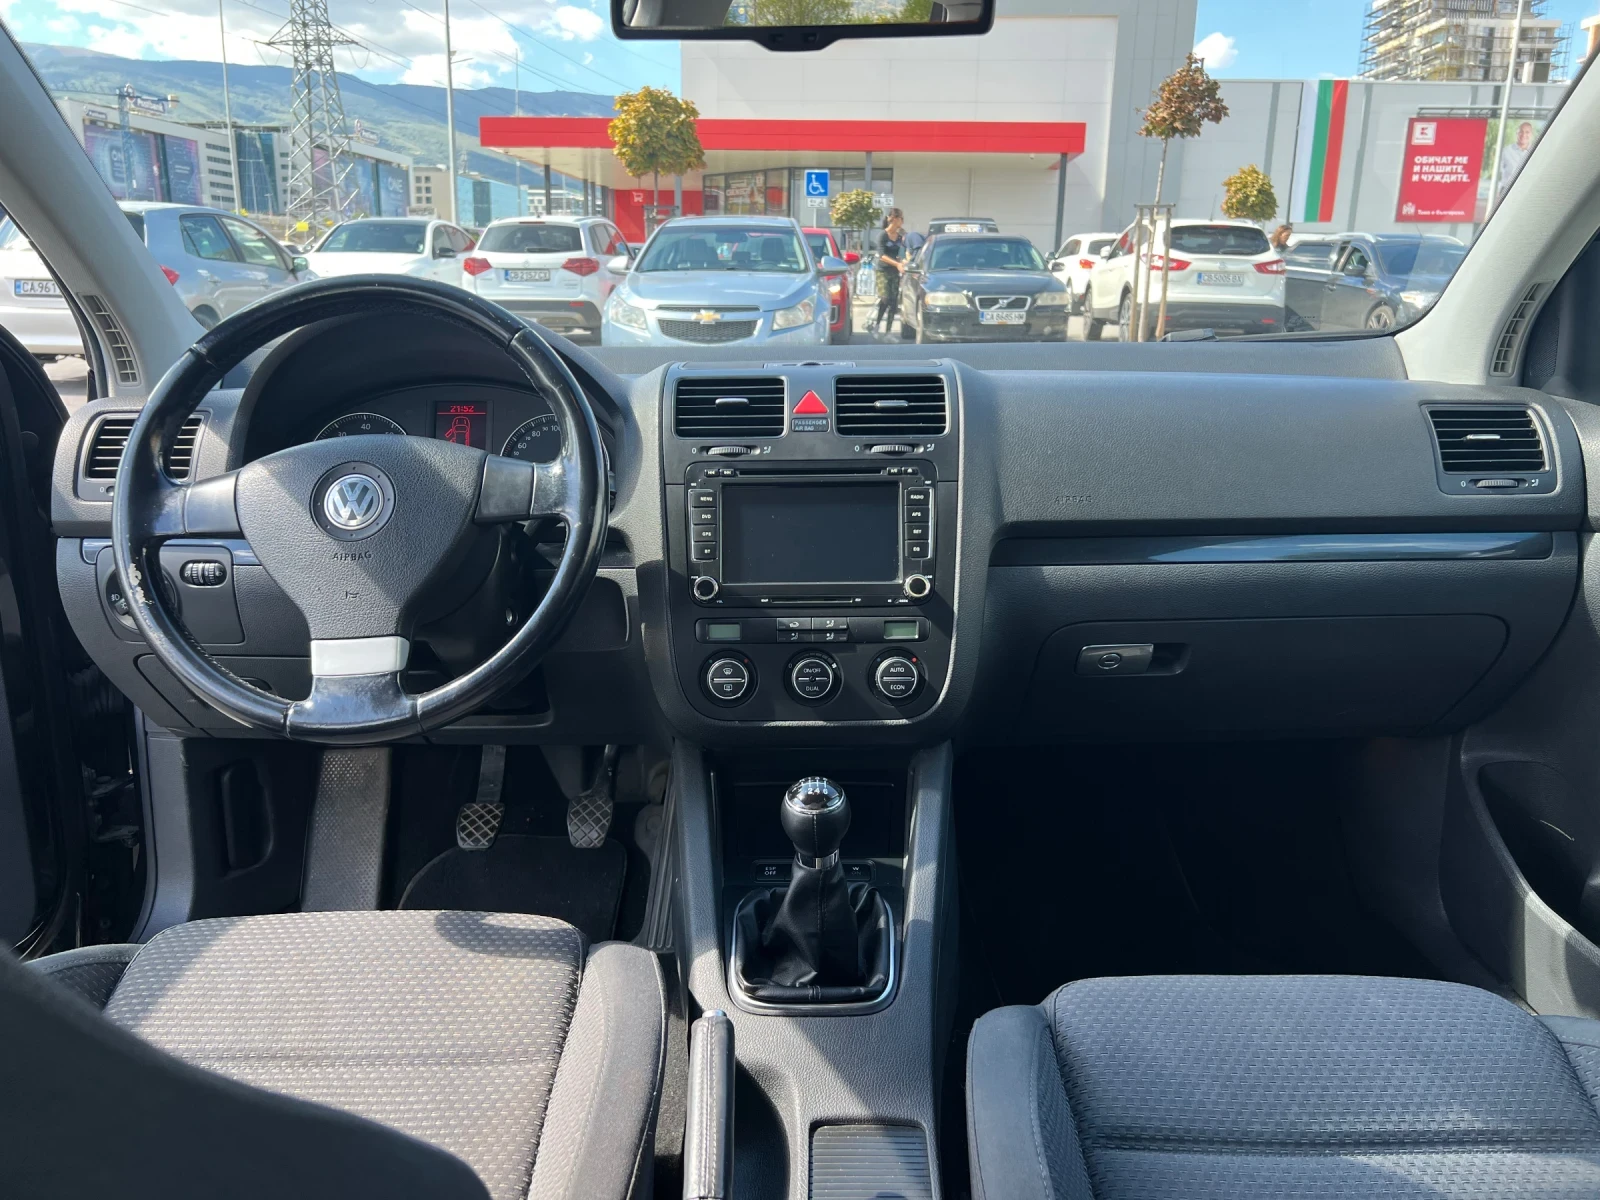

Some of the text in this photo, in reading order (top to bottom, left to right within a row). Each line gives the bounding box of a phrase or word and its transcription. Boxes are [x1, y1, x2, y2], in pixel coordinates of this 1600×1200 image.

[1414, 156, 1469, 165] ОБИЧАТ МЕ
[1413, 165, 1465, 174] И НАШИТЕ,
[1411, 174, 1471, 183] И ЧУЖДИТЕ.
[22, 281, 62, 294] CA 961
[450, 405, 474, 413] 21:52
[517, 442, 527, 450] 60
[333, 550, 372, 561] AIRBAG
[807, 787, 813, 795] 2
